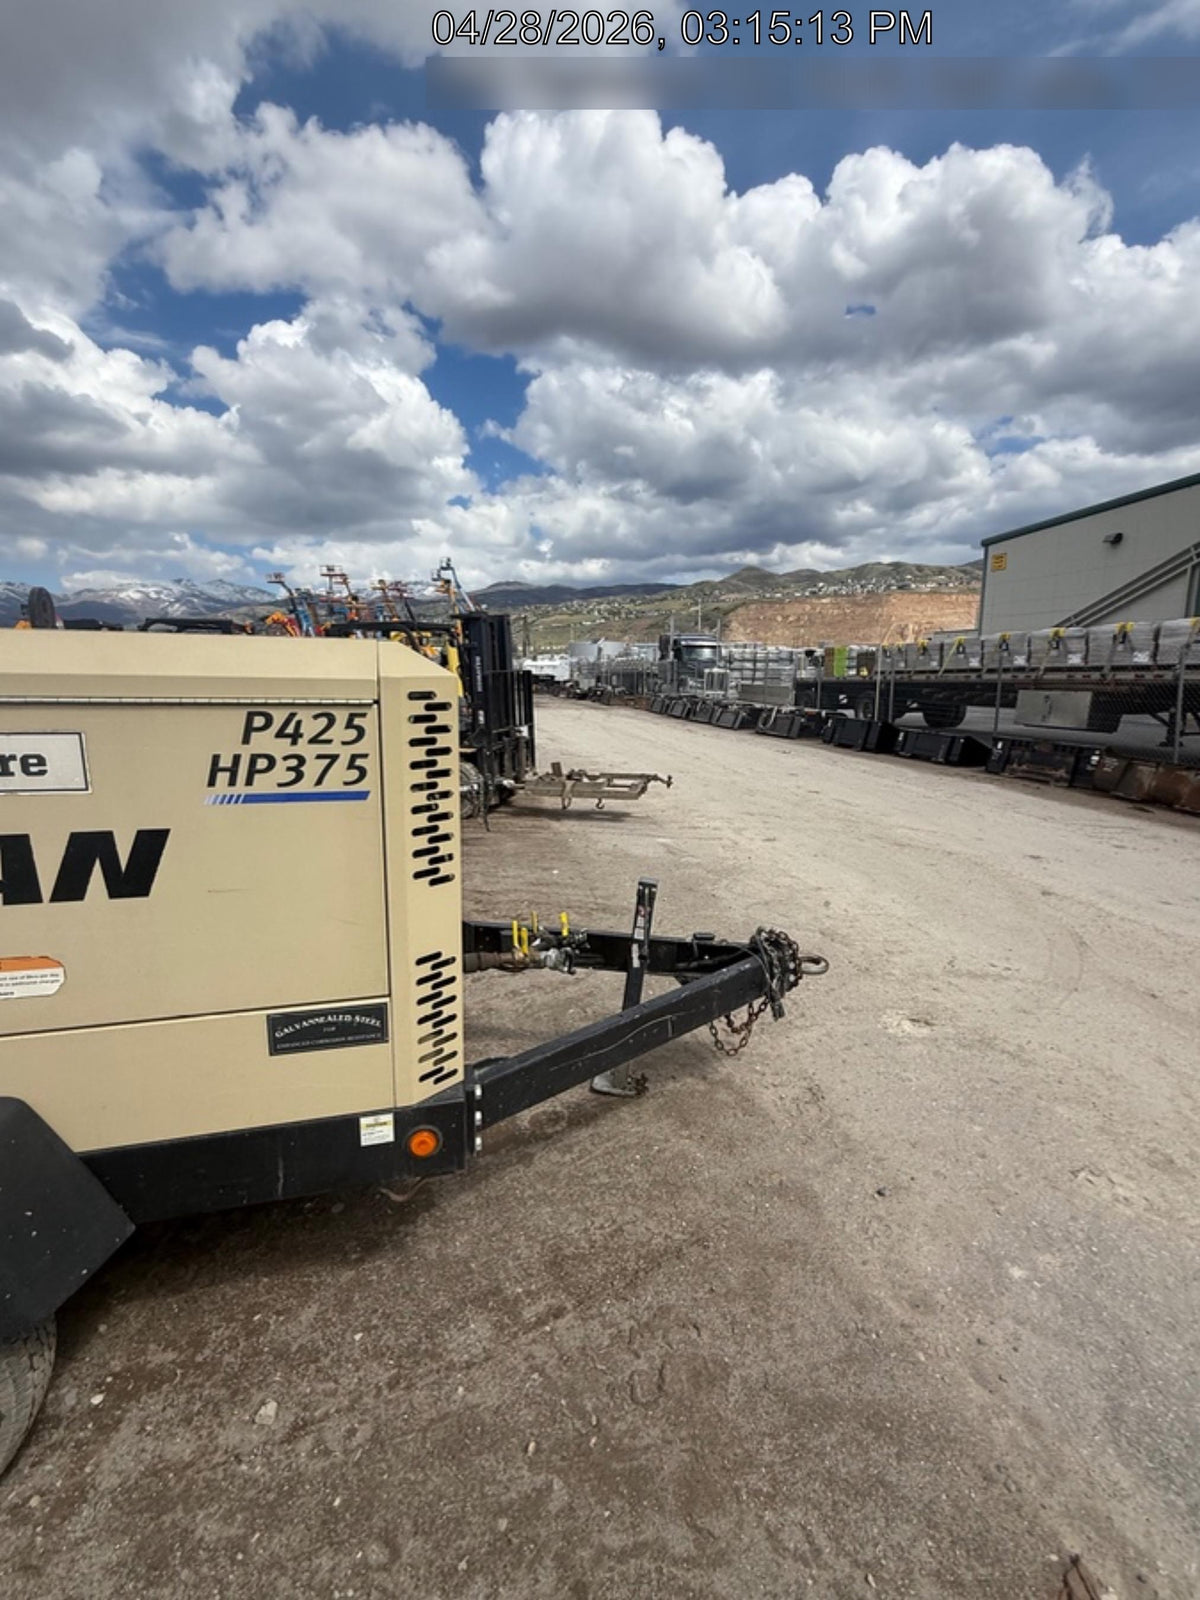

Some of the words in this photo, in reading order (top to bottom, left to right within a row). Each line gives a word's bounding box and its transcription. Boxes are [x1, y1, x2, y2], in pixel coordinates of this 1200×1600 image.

[241, 710, 368, 746] P425
[207, 753, 369, 787] HP375
[354, 1014, 382, 1028] STEEL
